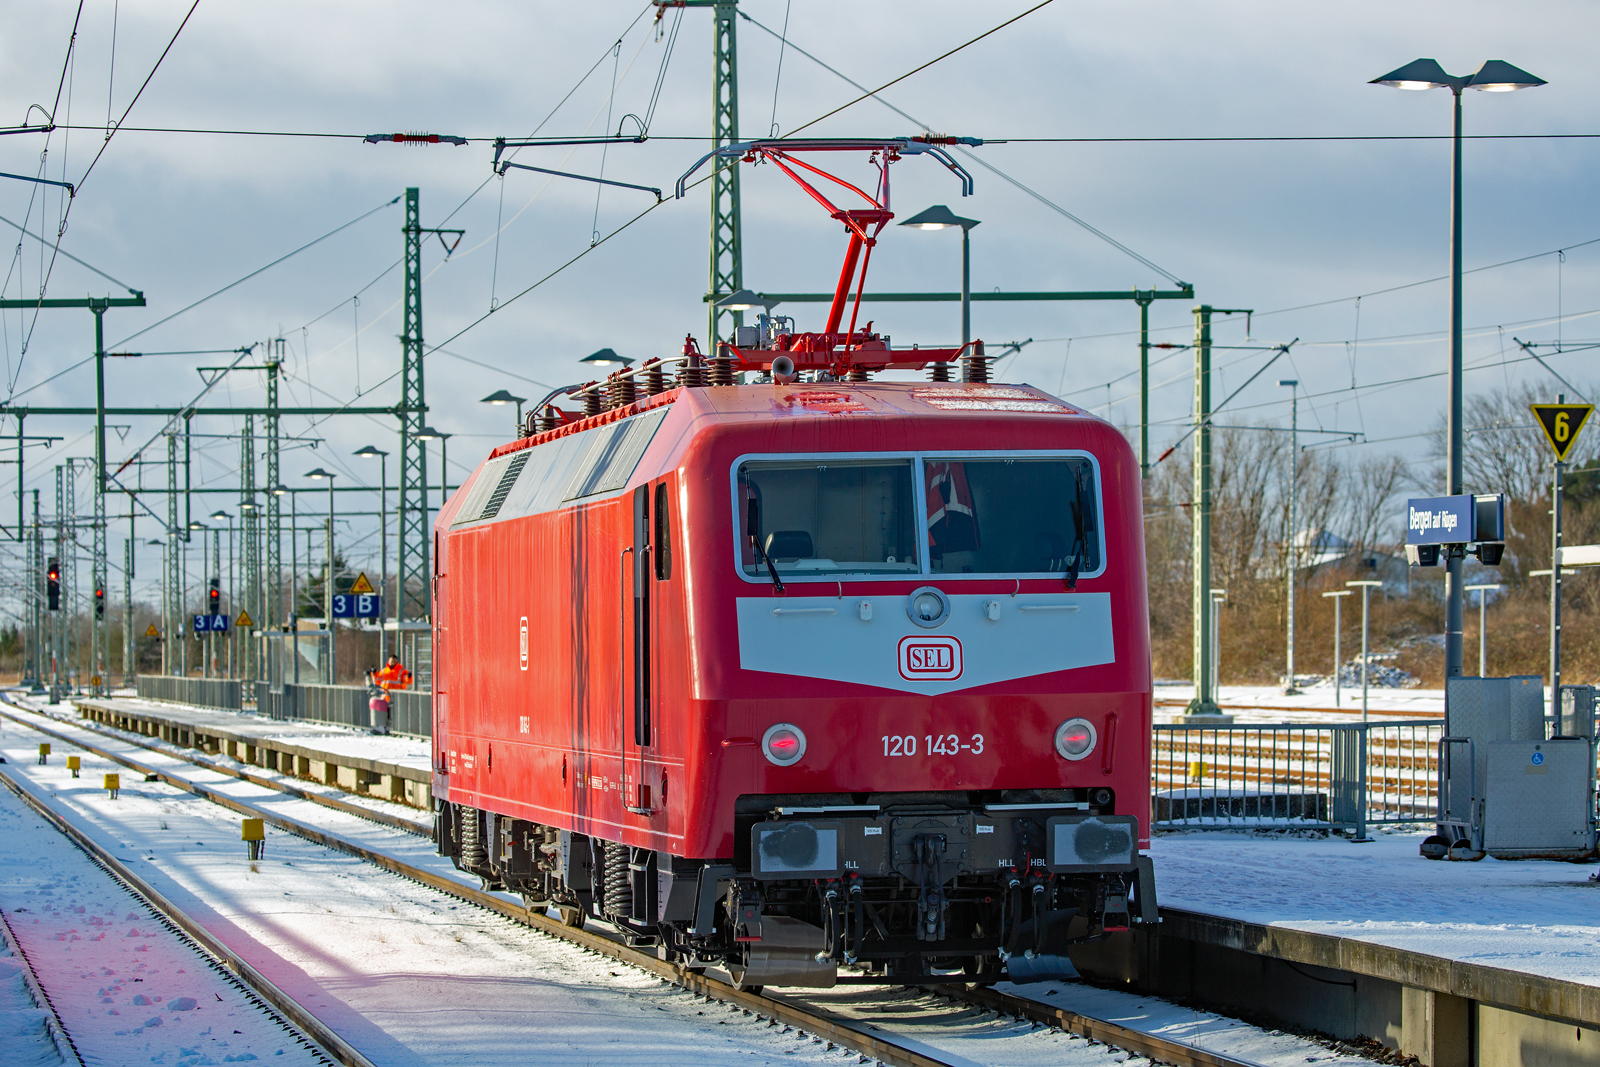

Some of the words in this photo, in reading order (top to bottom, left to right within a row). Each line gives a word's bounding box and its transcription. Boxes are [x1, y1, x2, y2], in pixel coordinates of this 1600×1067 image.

[1554, 411, 1570, 442] 6
[1409, 506, 1432, 536] Bergen
[1432, 511, 1441, 529] auf
[1441, 510, 1458, 533] Rügen
[334, 595, 346, 613] 3
[358, 595, 372, 613] B
[195, 617, 204, 629] 3
[213, 617, 225, 629] A
[912, 648, 949, 668] SEL
[881, 735, 917, 757] 120
[925, 733, 984, 756] 143-3
[998, 859, 1015, 867] HLL
[1030, 858, 1047, 867] HBL
